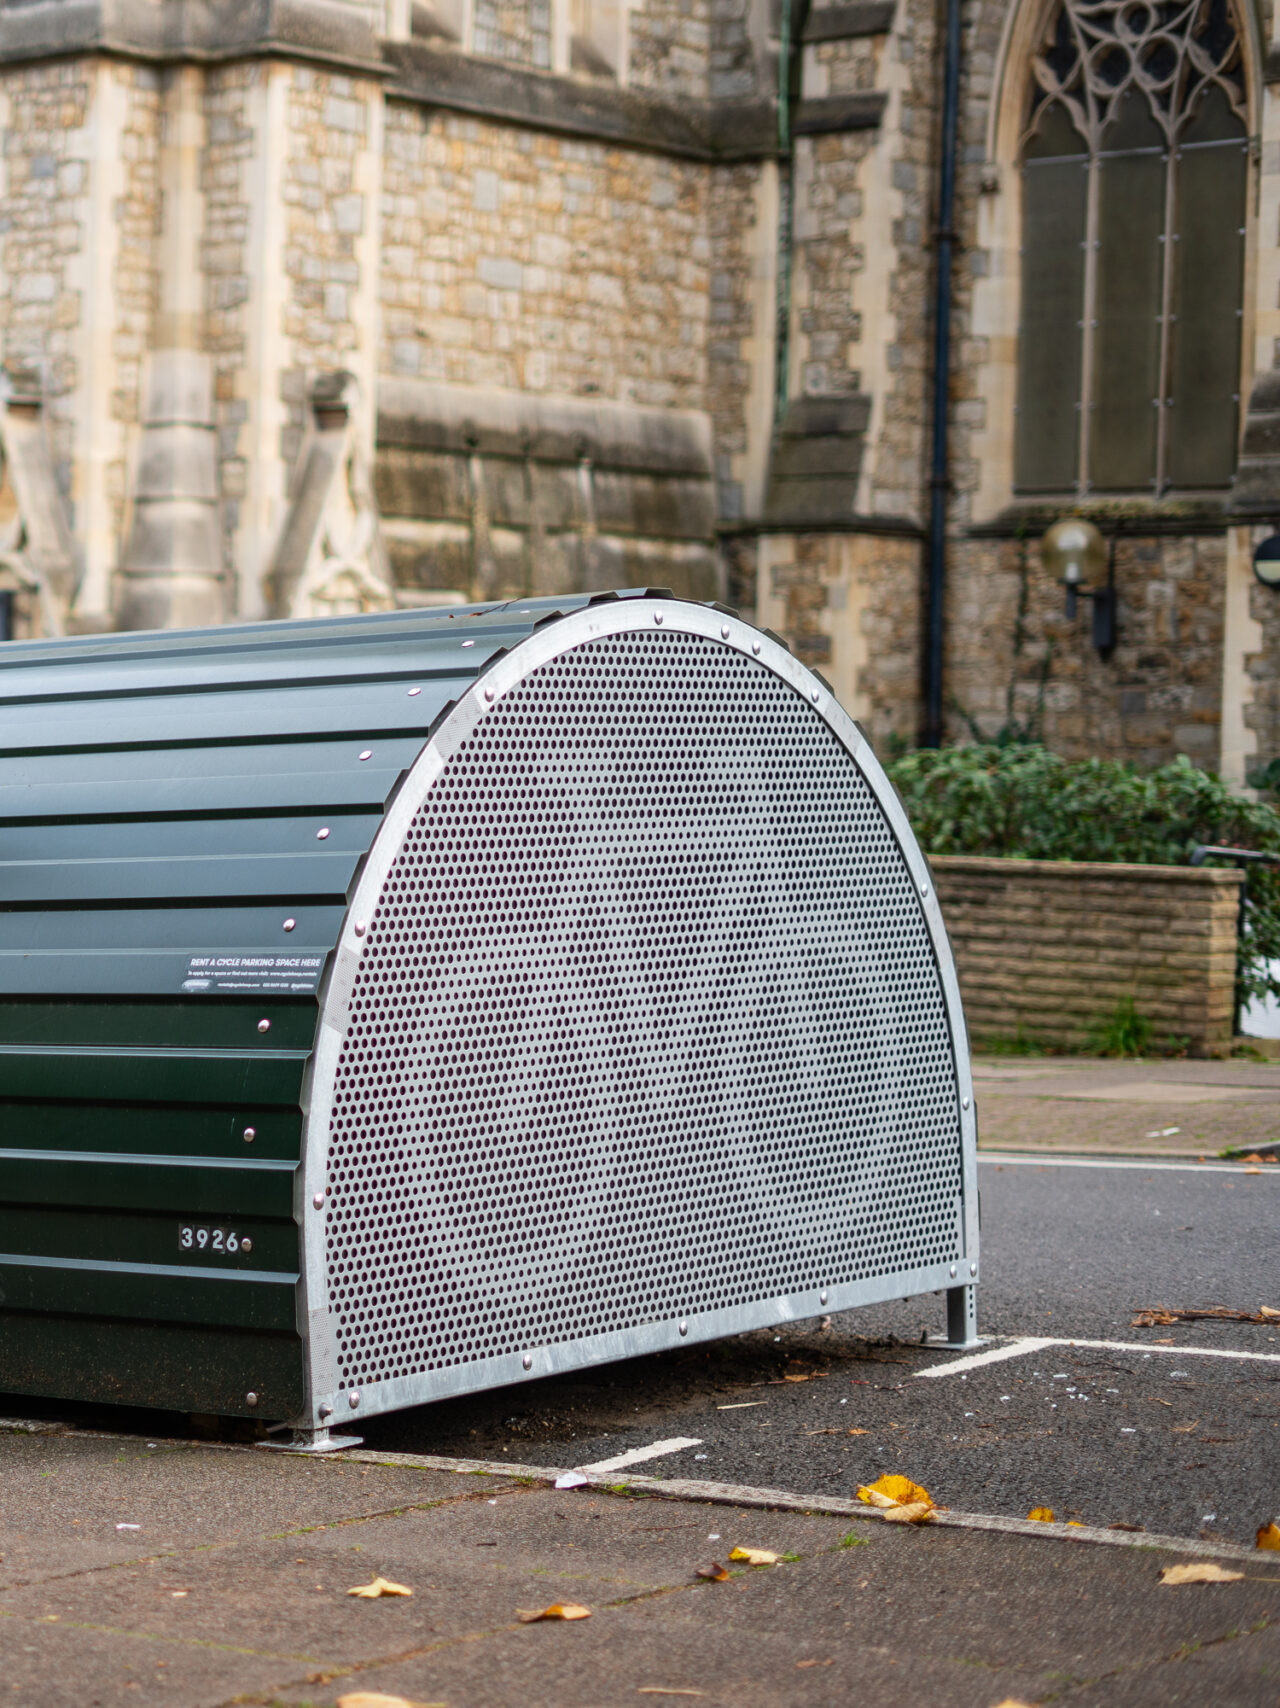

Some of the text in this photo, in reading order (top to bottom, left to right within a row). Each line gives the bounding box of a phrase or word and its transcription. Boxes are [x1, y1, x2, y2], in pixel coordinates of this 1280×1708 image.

[190, 958, 321, 966] RENT A CYCLE PARKING SPACE HERE
[181, 1227, 239, 1252] 3926
